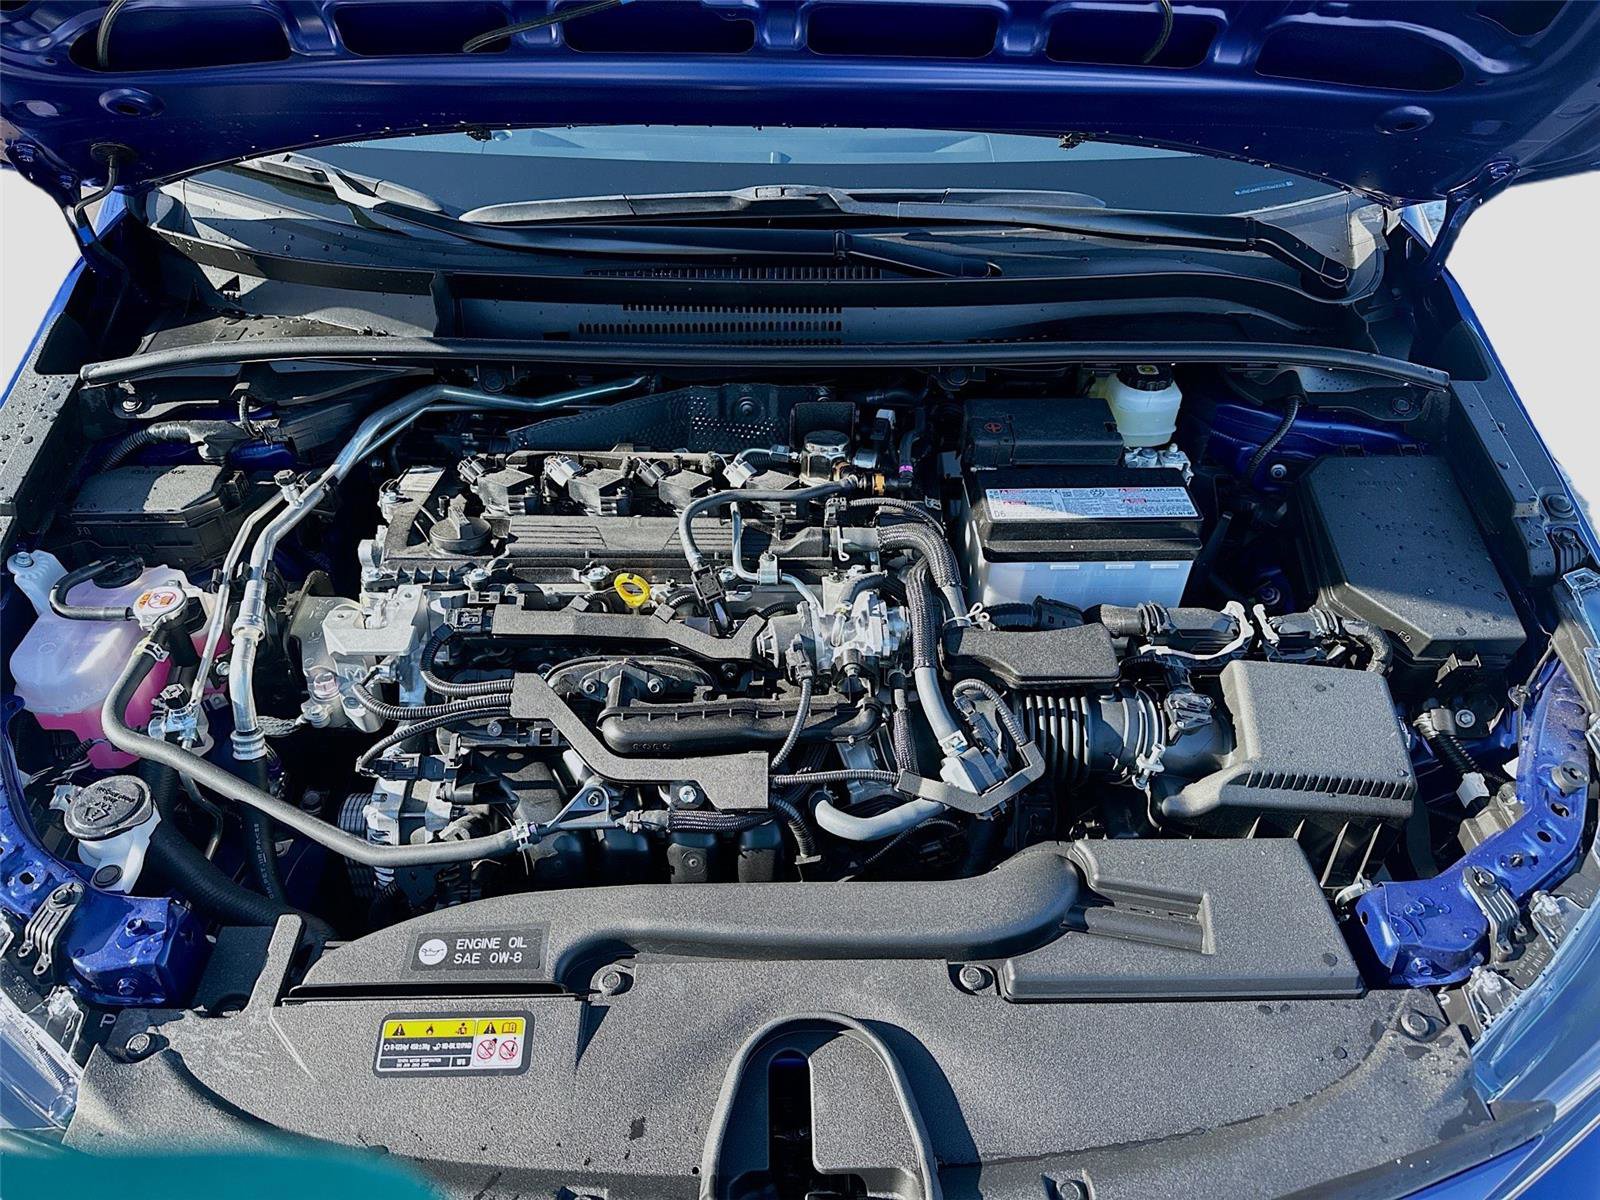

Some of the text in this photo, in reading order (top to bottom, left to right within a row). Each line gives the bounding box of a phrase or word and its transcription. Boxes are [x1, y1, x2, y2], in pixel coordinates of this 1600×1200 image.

[456, 936, 528, 950] ENGINE OIL
[453, 951, 523, 965] SAE 0W-8
